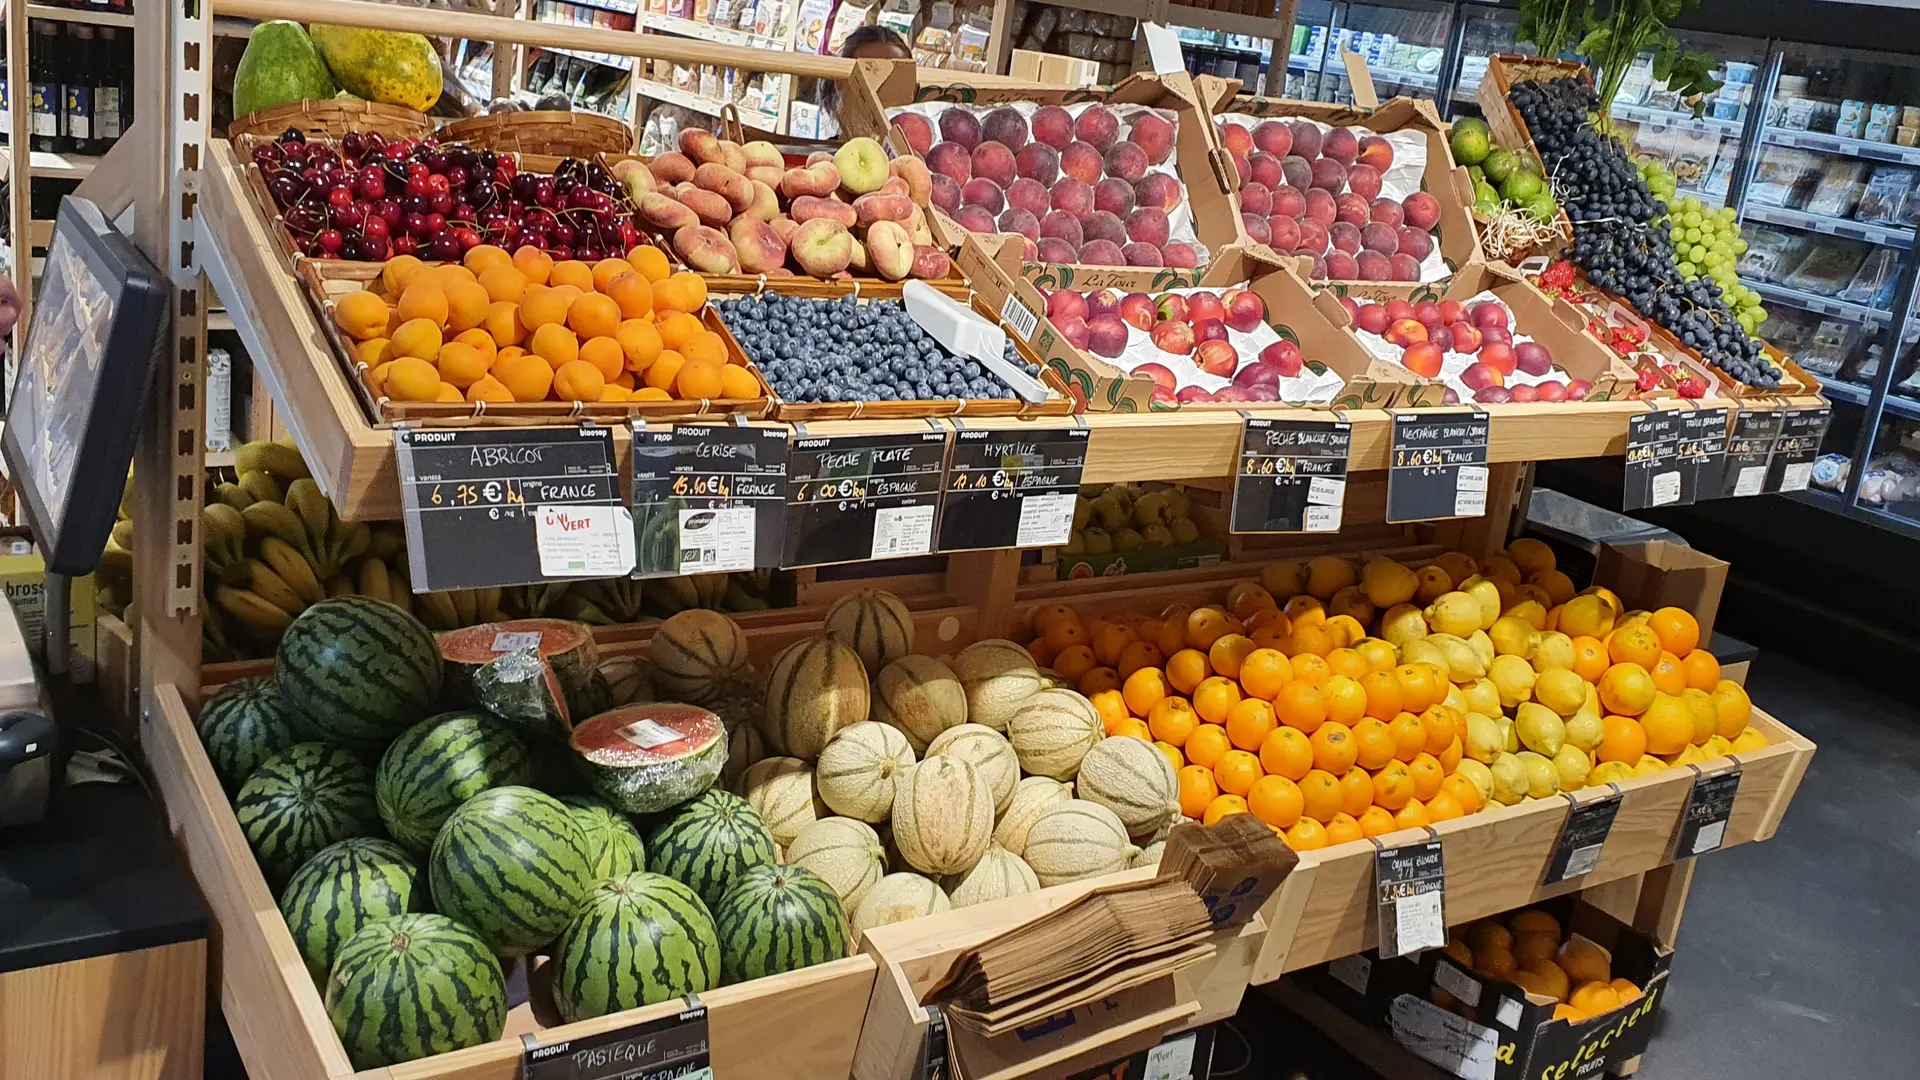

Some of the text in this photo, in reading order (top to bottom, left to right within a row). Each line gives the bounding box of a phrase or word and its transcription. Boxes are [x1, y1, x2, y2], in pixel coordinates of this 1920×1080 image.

[1082, 273, 1136, 288] La Tour
[414, 432, 457, 443] PRODUIT
[677, 427, 711, 437] PRODUIT
[960, 431, 989, 440] PRODUIT
[1265, 429, 1297, 446] PECHE
[798, 439, 831, 448] PRODUIT
[872, 447, 913, 464] PLATE
[1447, 451, 1474, 463] FRANCE
[1302, 462, 1333, 472] FRANCE
[522, 480, 543, 489] origine
[876, 479, 918, 496] ESPAGNE
[1021, 475, 1060, 488] ESPAGNE
[540, 484, 597, 500] FRANCE
[736, 483, 776, 496] FRANCE
[561, 518, 591, 532] VERT
[1541, 988, 1658, 1080] selected
[532, 1042, 570, 1059] PRODUIT
[572, 1039, 657, 1070] PASTEQUE
